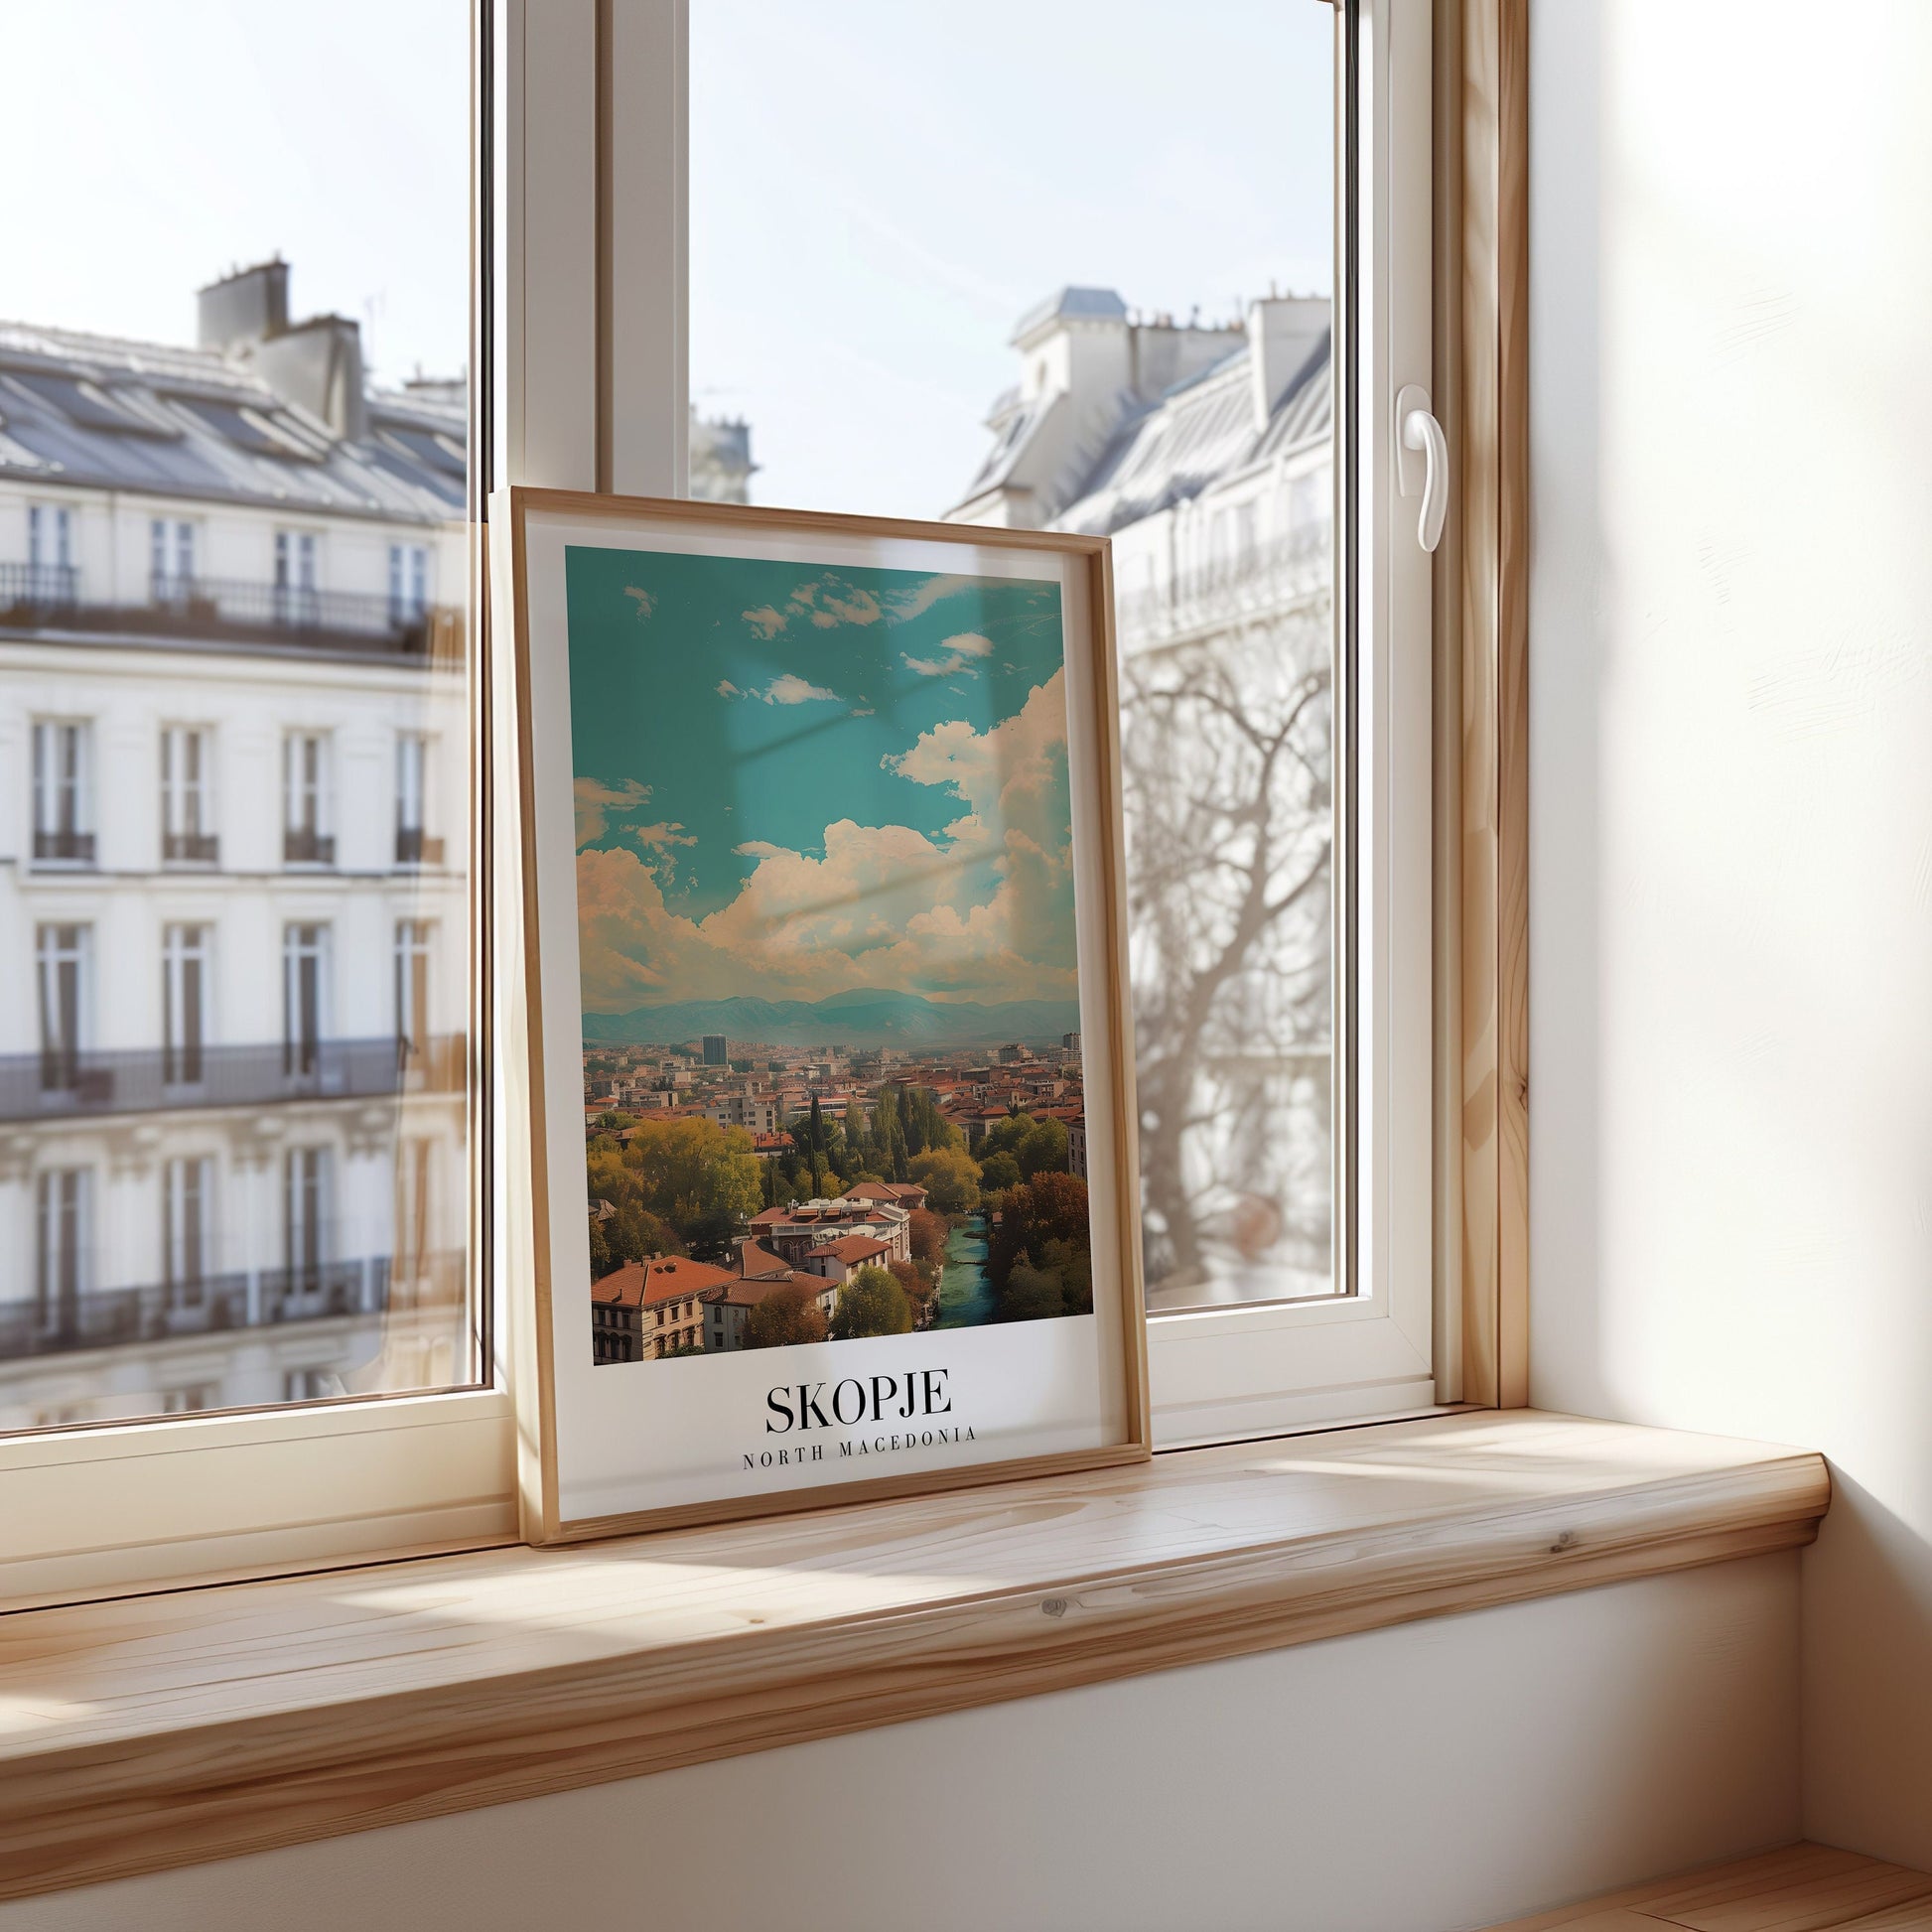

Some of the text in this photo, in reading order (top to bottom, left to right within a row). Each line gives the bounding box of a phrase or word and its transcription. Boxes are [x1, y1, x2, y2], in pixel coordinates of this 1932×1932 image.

[766, 1368, 952, 1434] SKOPJE
[743, 1426, 977, 1470] NORTH MACEDONIA
